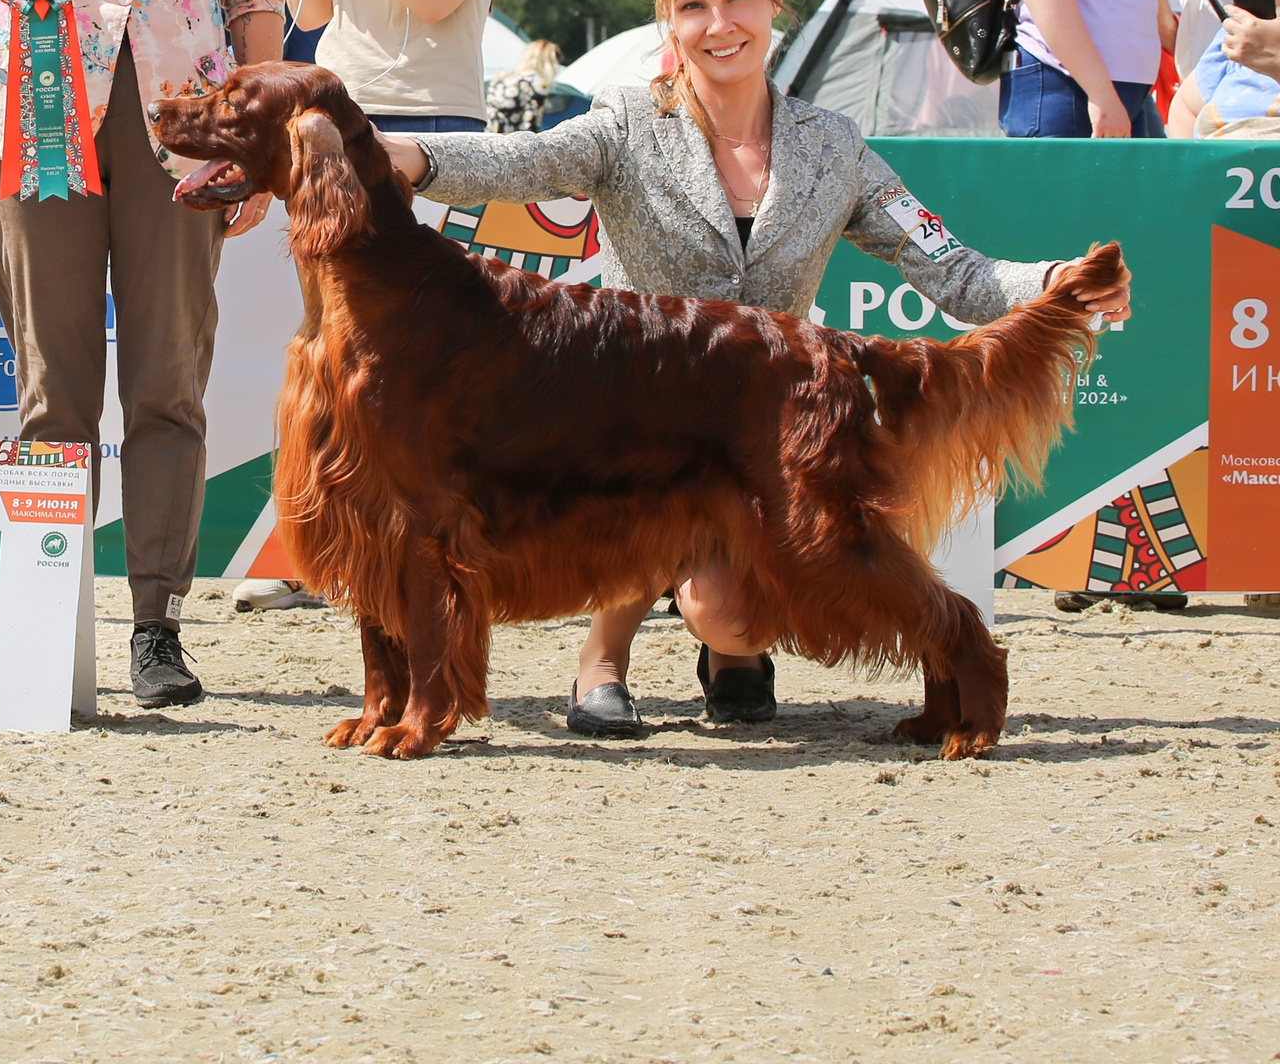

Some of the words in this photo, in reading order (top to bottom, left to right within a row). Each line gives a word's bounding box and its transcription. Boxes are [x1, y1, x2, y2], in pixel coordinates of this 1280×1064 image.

[1225, 167, 1280, 209] 20
[51, 471, 80, 479] ПОРОД
[29, 479, 74, 488] ВЫСТАВКИ
[12, 498, 33, 508] 8-9
[37, 499, 78, 510] ИЮНЯ
[11, 510, 54, 518] МАКСИМА
[55, 511, 77, 519] ПАРК
[37, 560, 70, 568] РОССИЯ
